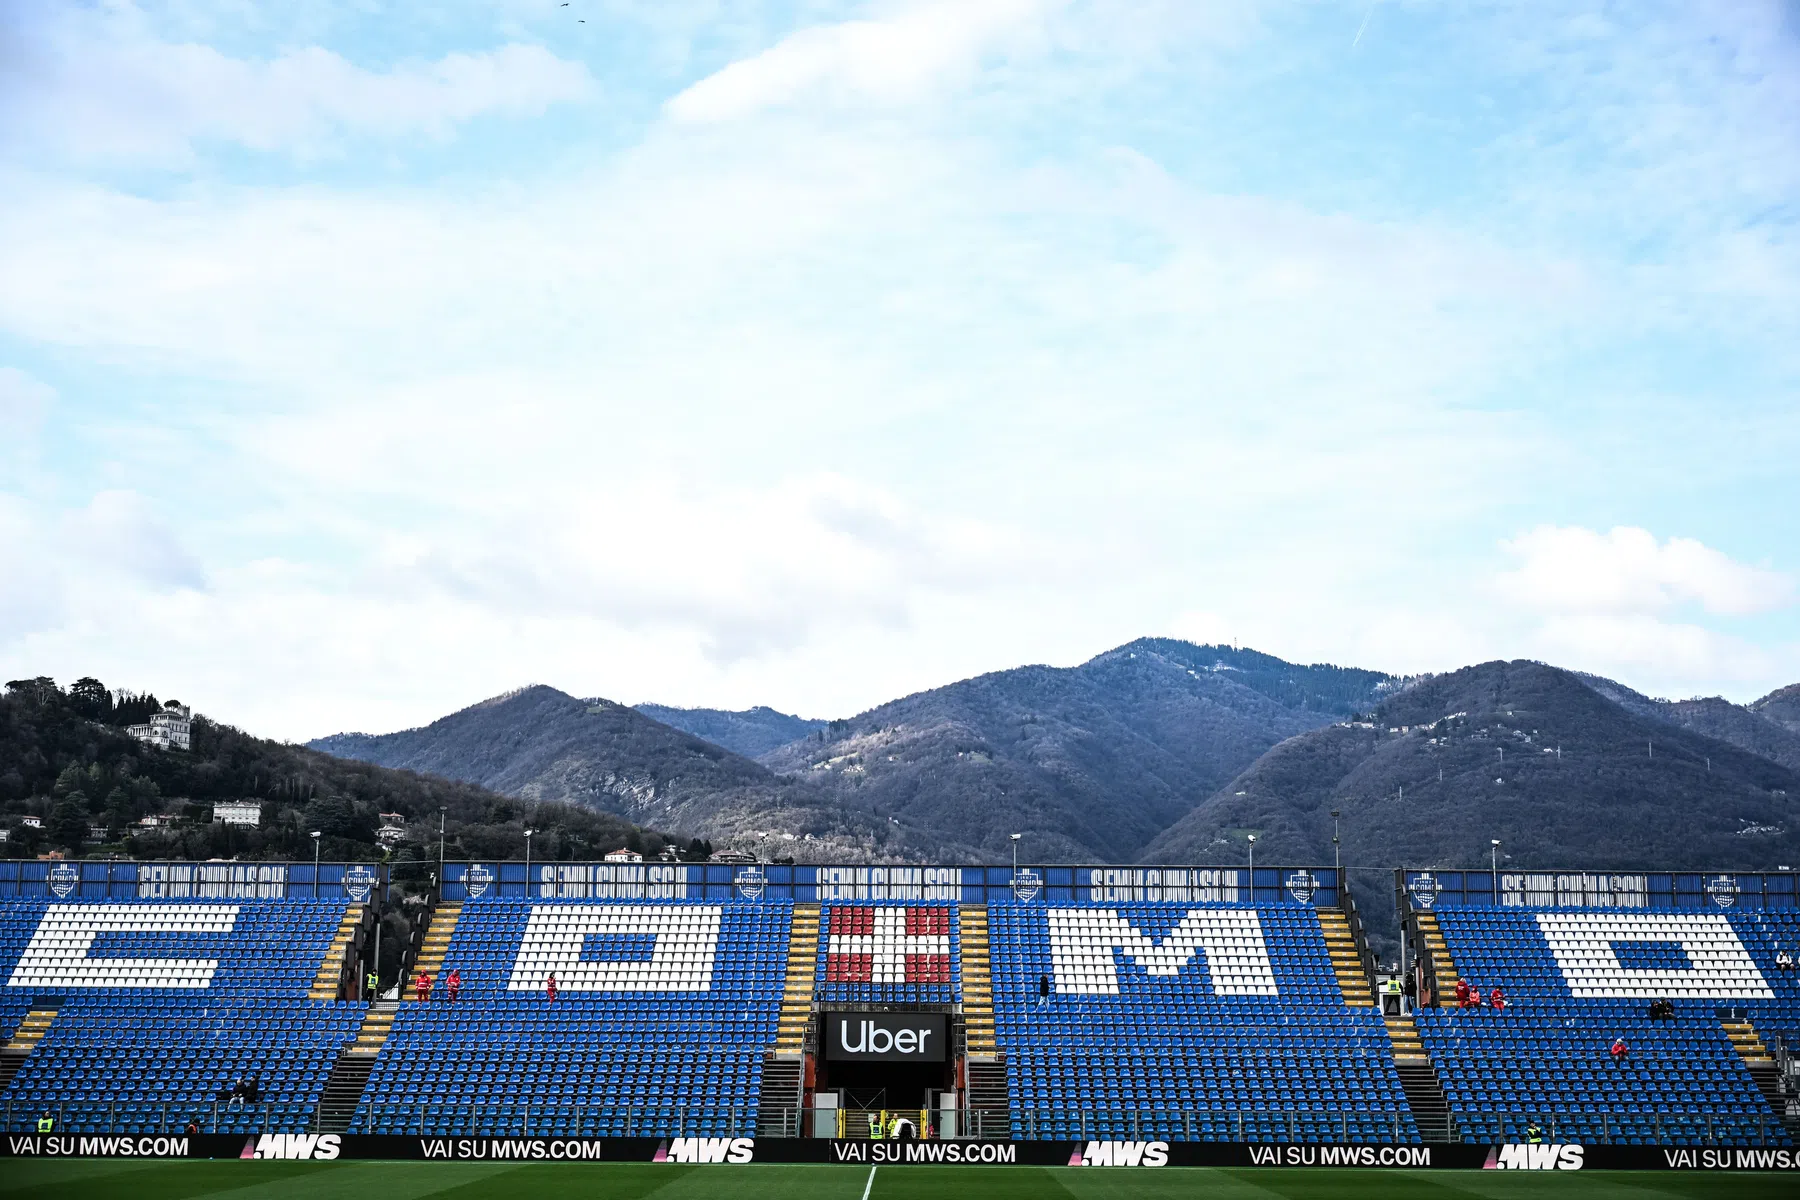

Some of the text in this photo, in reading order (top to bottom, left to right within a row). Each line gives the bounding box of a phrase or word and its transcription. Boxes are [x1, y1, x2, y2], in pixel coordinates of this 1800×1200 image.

[841, 1020, 931, 1054] Uber
[9, 1136, 189, 1156] VAI SU MWS.COM
[420, 1139, 601, 1159] VAI SU MWS.COM
[834, 1143, 1016, 1162] VAI SU MWS.COM
[1249, 1146, 1431, 1166] VAI SU MWS.COM
[1664, 1149, 1697, 1168] VAI
[1702, 1149, 1731, 1168] SU
